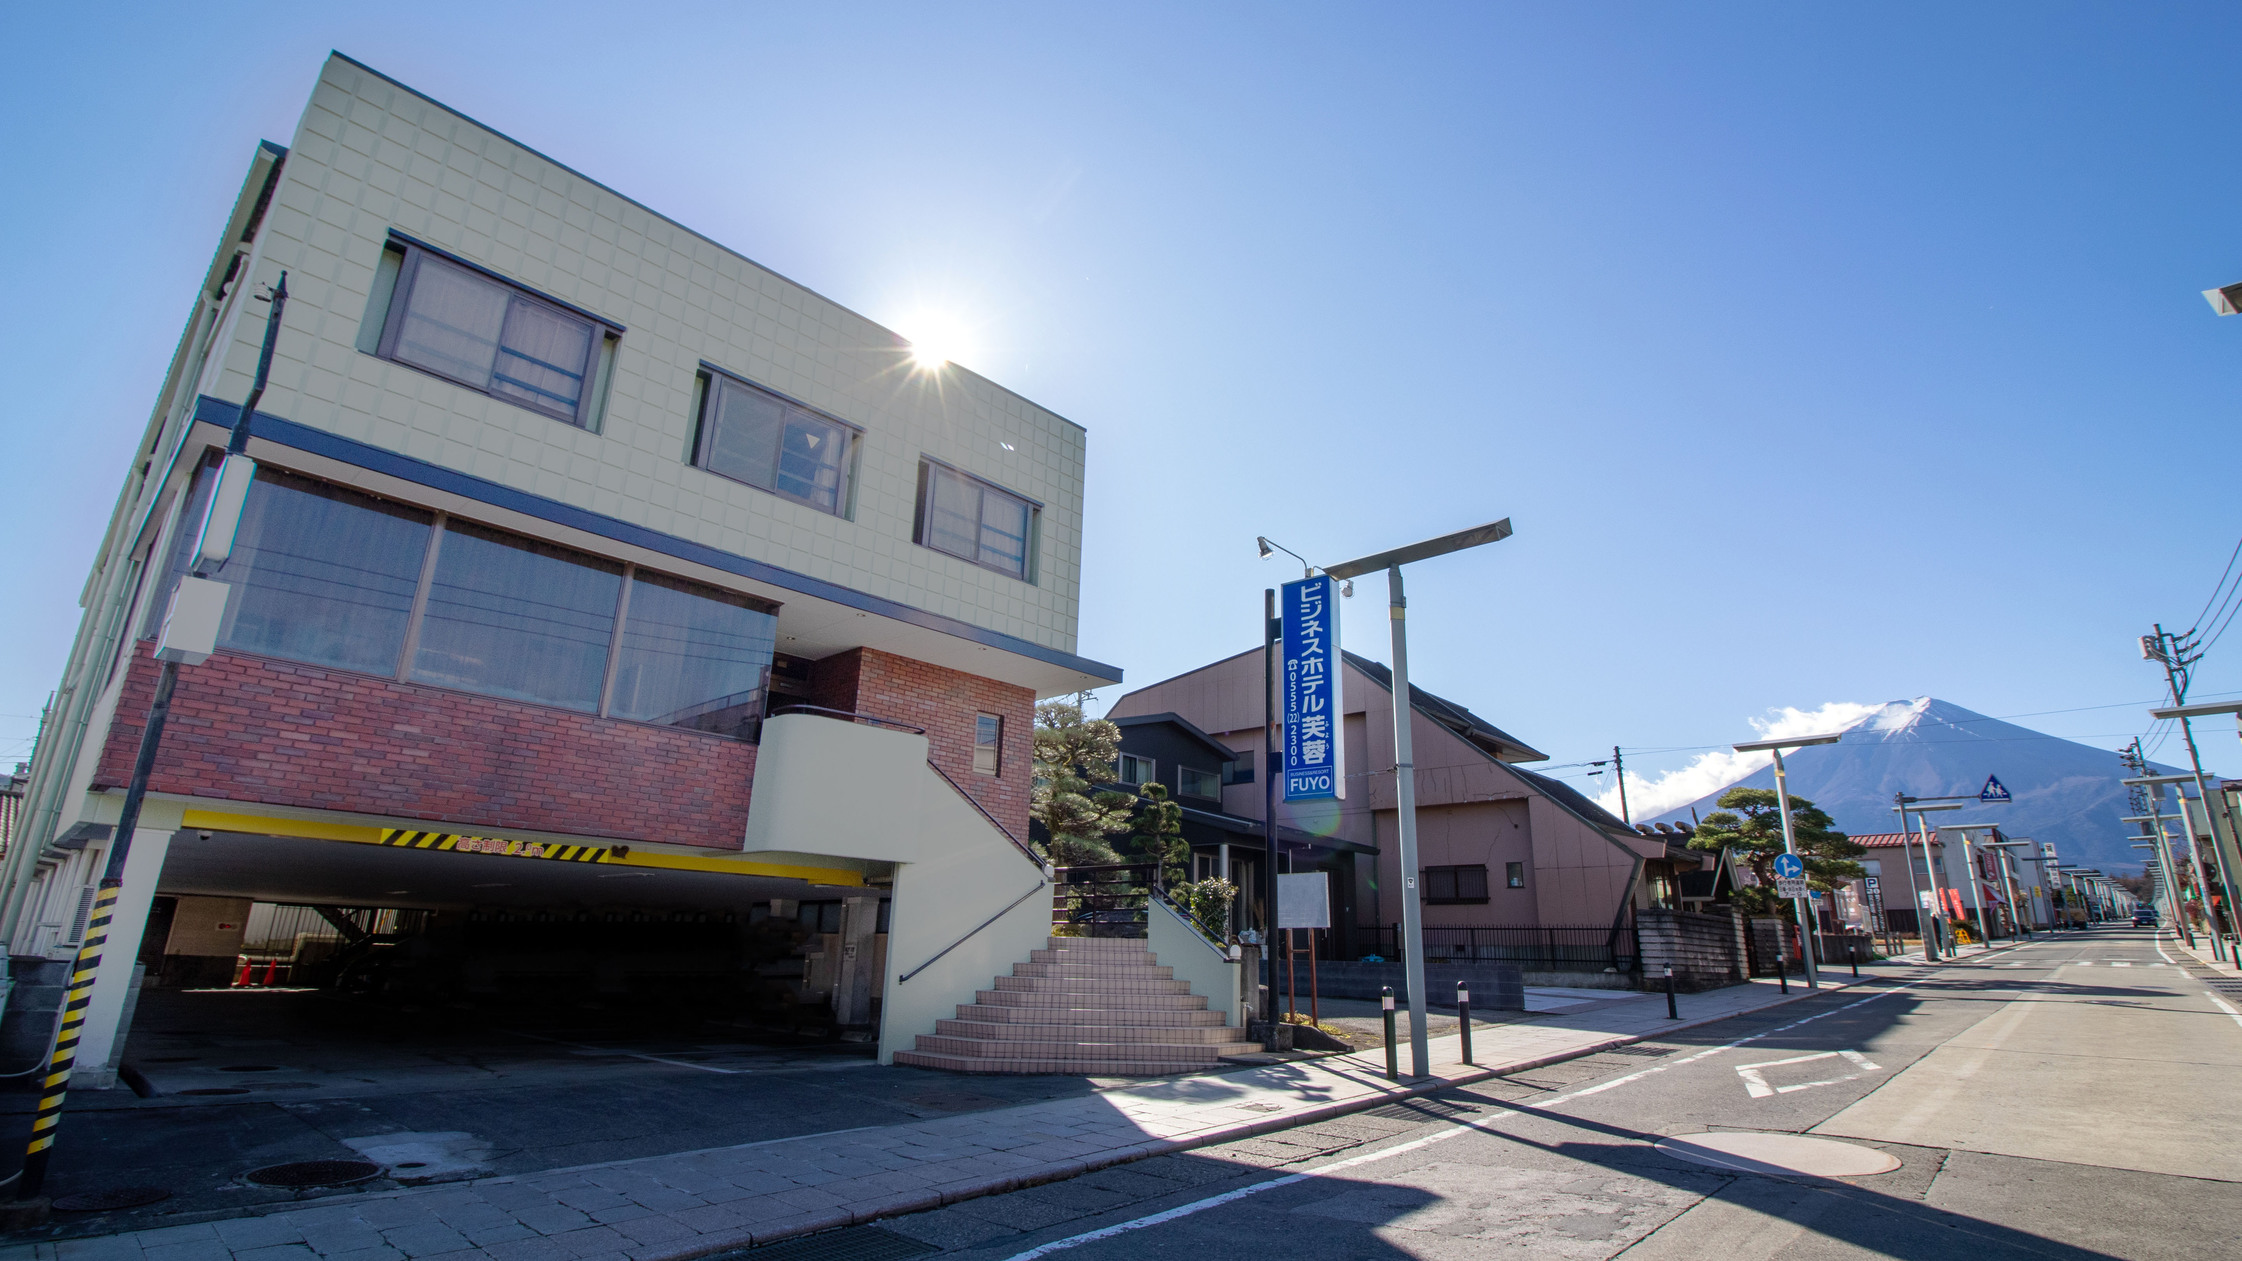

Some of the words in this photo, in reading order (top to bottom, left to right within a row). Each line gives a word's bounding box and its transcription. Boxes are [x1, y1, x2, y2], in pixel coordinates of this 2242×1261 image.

[1301, 582, 1326, 765] ビジネスホテル芙蓉
[1287, 671, 1300, 766] 0555(22)2300
[1290, 775, 1330, 792] FUYO
[456, 837, 508, 854] 高さ制限
